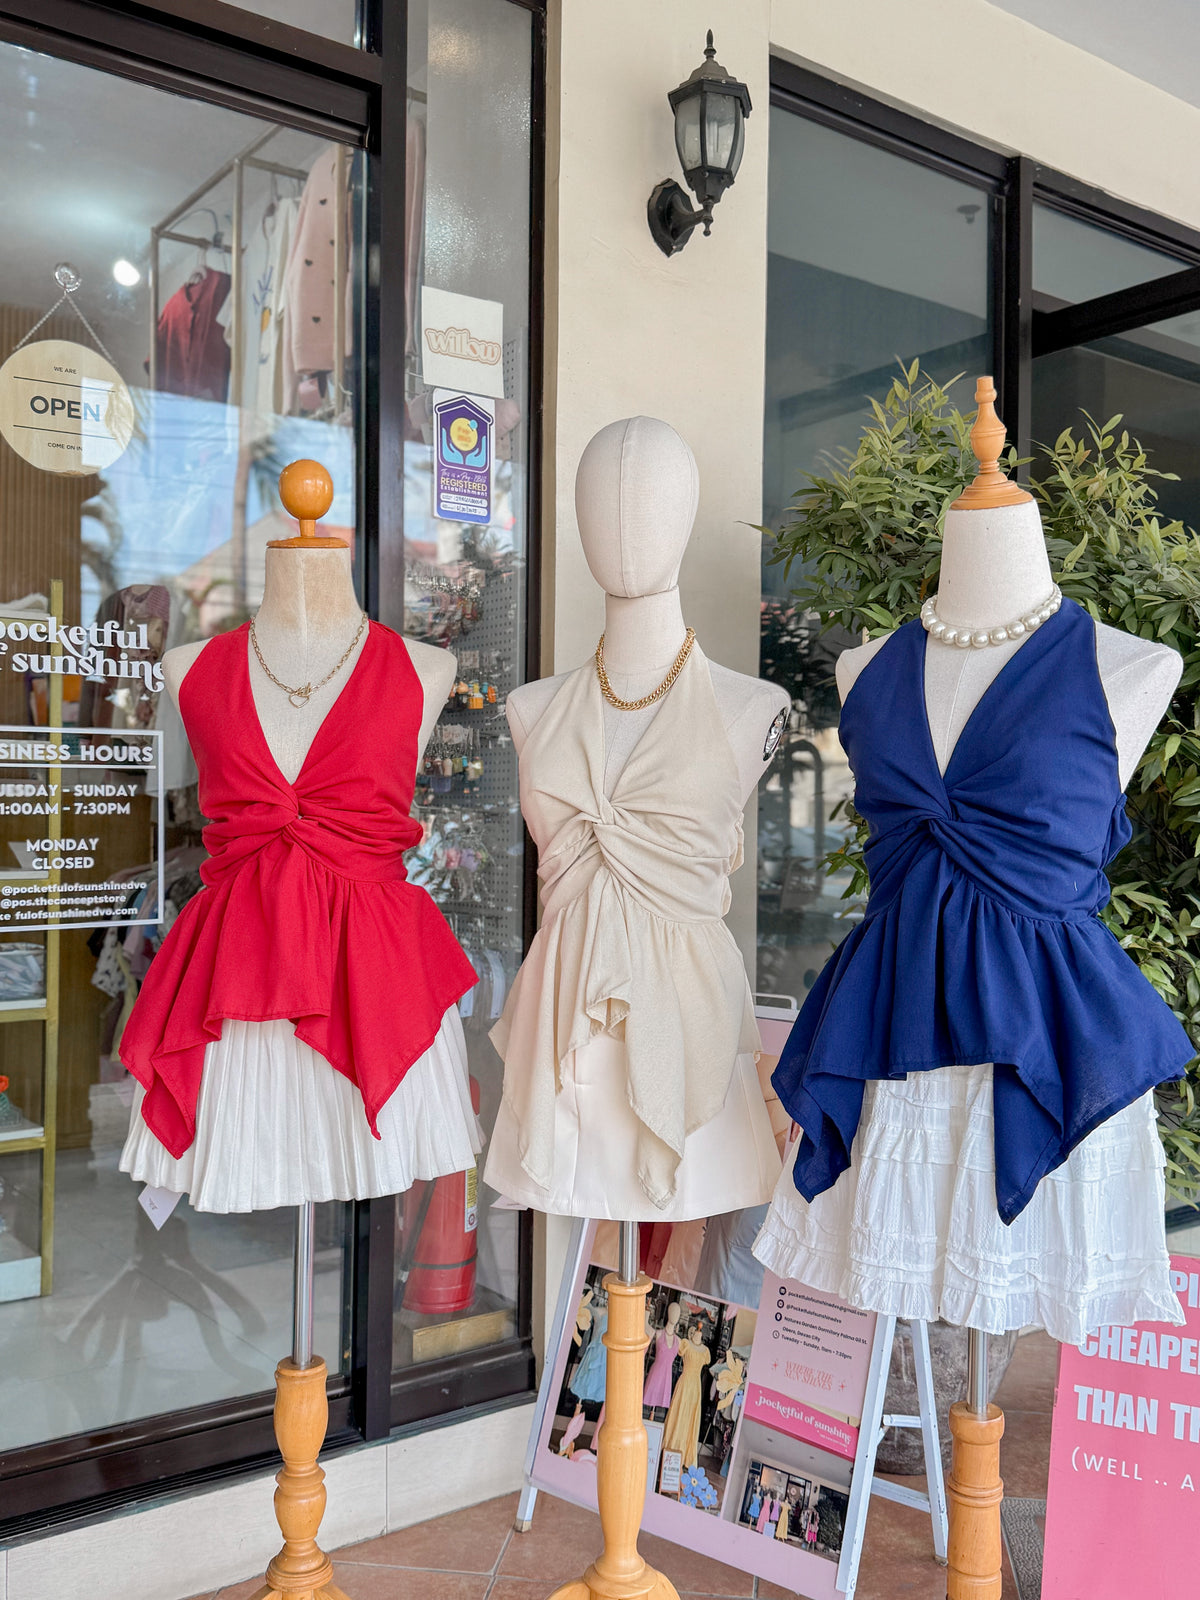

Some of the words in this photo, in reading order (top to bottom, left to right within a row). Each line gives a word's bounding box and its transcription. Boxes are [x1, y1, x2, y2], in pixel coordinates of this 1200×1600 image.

[30, 395, 100, 422] OPEN
[47, 442, 65, 450] COME
[440, 477, 488, 492] REGISTERED
[440, 484, 488, 497] Establishment
[80, 745, 154, 762] HOURS
[73, 784, 138, 797] SUNDAY
[73, 802, 131, 815] 7:30PM
[26, 838, 99, 852] MONDAY
[32, 856, 95, 870] CLOSED
[1, 881, 147, 896] @pocketfulofsunshinedvo
[0, 894, 127, 909] @pos.theconceptstore
[781, 1334, 800, 1345] Tuesday
[1078, 1325, 1200, 1375] CHEAPE
[784, 1369, 800, 1382] SUN
[817, 1370, 834, 1384] THE
[755, 1396, 804, 1419] pocketful
[804, 1415, 815, 1425] of
[1074, 1384, 1159, 1435] THAN
[1072, 1446, 1142, 1480] (WELL
